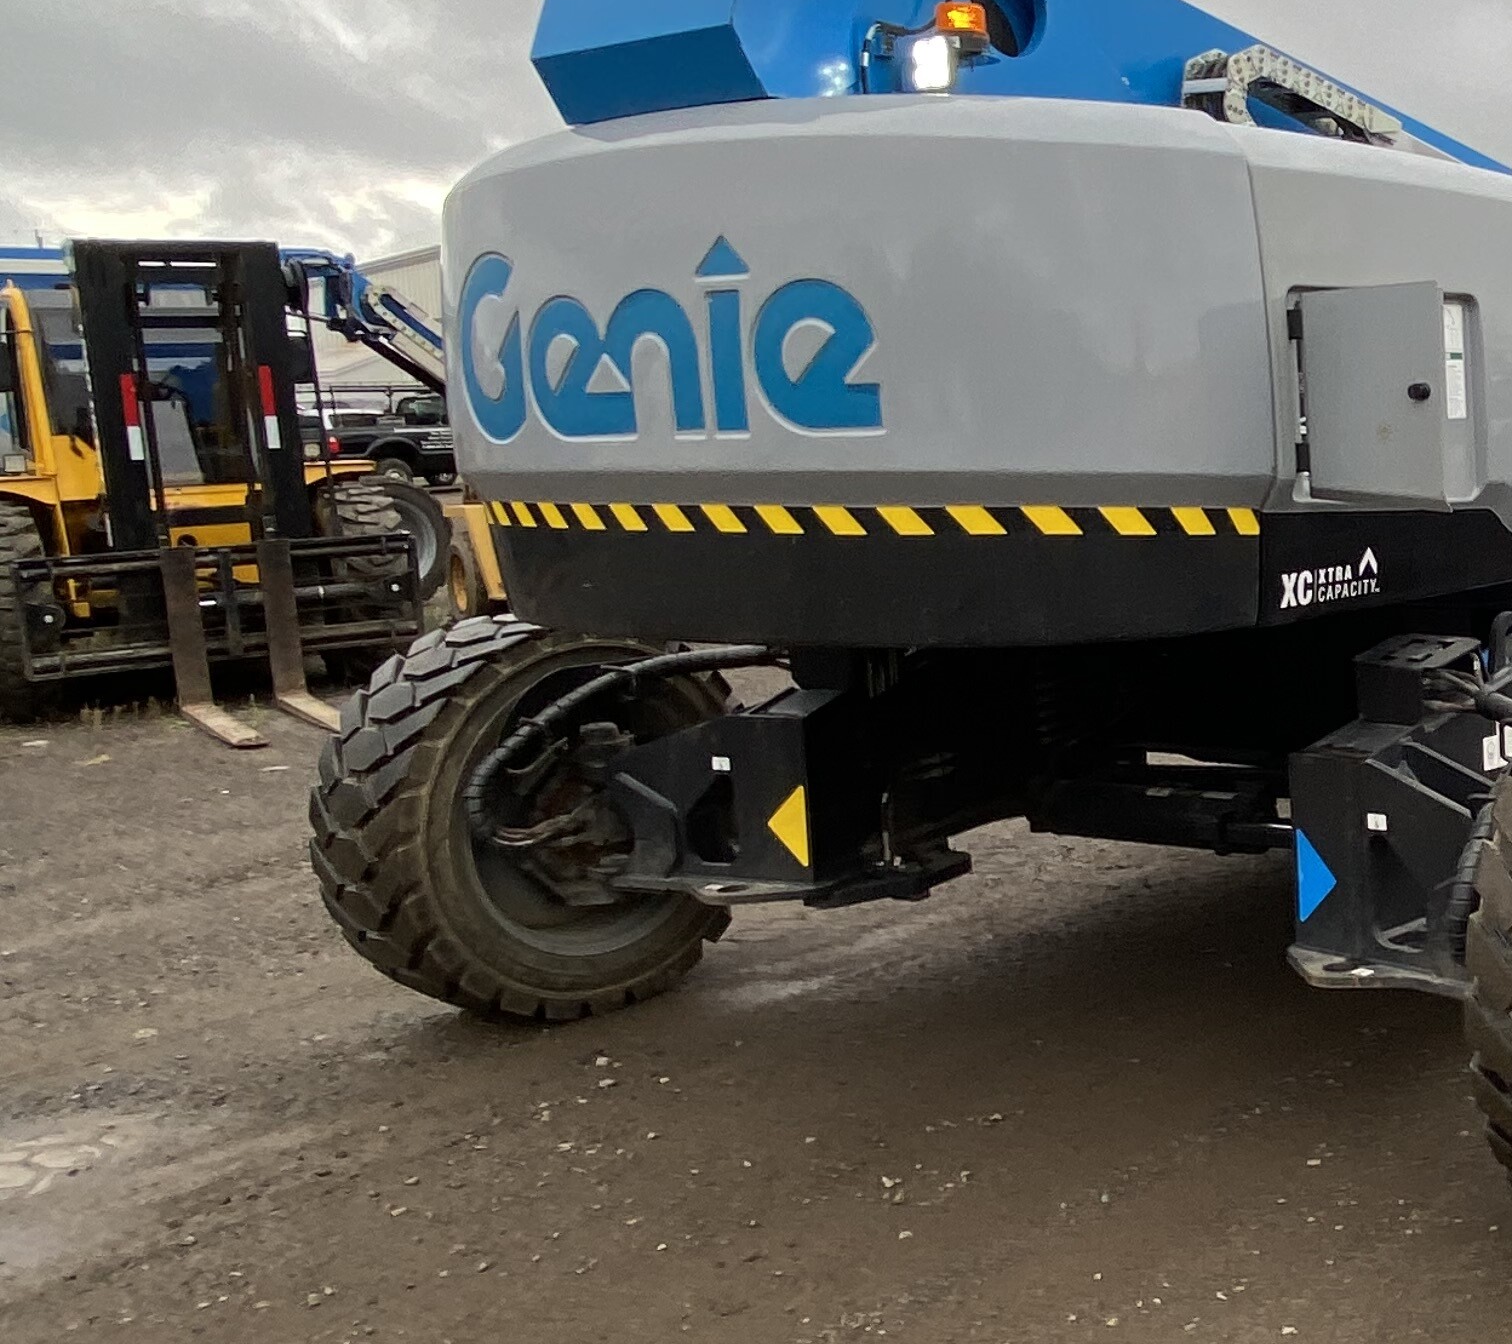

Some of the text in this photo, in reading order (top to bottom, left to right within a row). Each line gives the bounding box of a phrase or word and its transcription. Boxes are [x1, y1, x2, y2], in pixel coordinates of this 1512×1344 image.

[459, 235, 887, 444] Genie
[1280, 570, 1313, 609] XC
[1318, 564, 1353, 584] XTRA
[1318, 578, 1378, 603] CAPACITY
